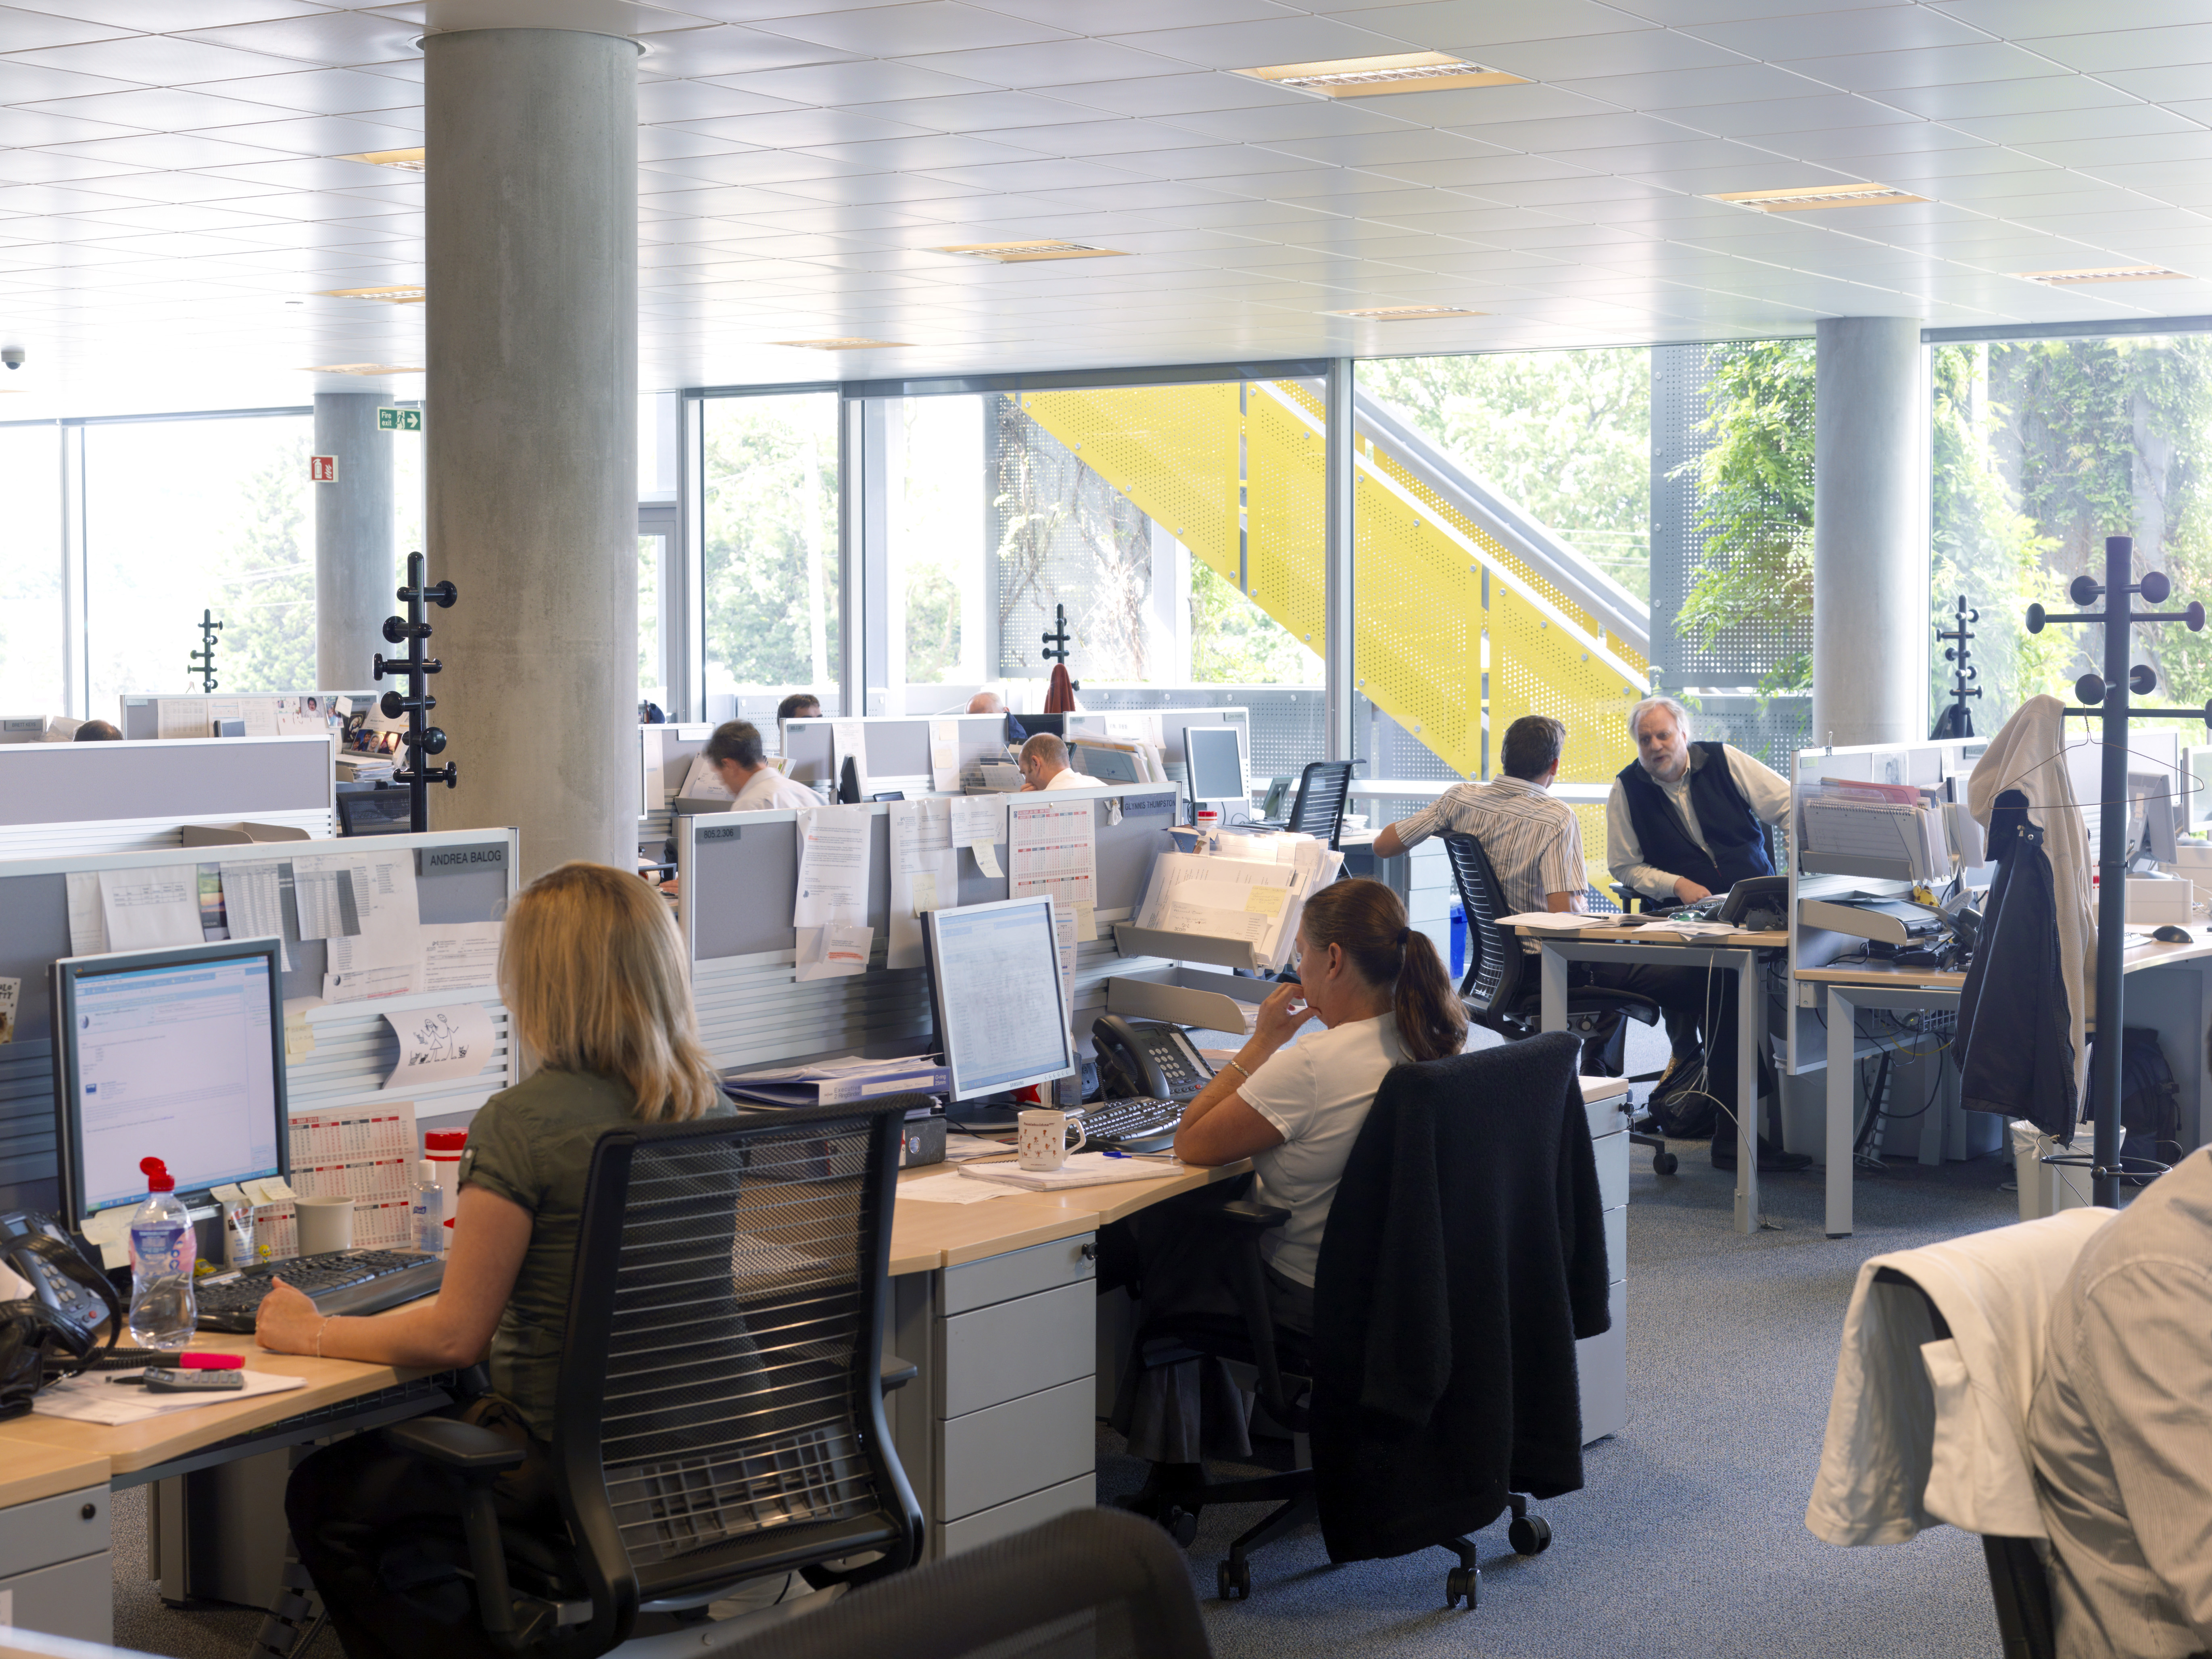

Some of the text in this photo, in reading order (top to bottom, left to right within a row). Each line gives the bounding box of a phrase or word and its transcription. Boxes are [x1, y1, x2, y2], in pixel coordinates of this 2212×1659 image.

[1125, 799, 1176, 810] GLYNNIS THUMPSTON
[704, 828, 734, 839] 805.2.306
[430, 850, 501, 866] ANDREA BALOG
